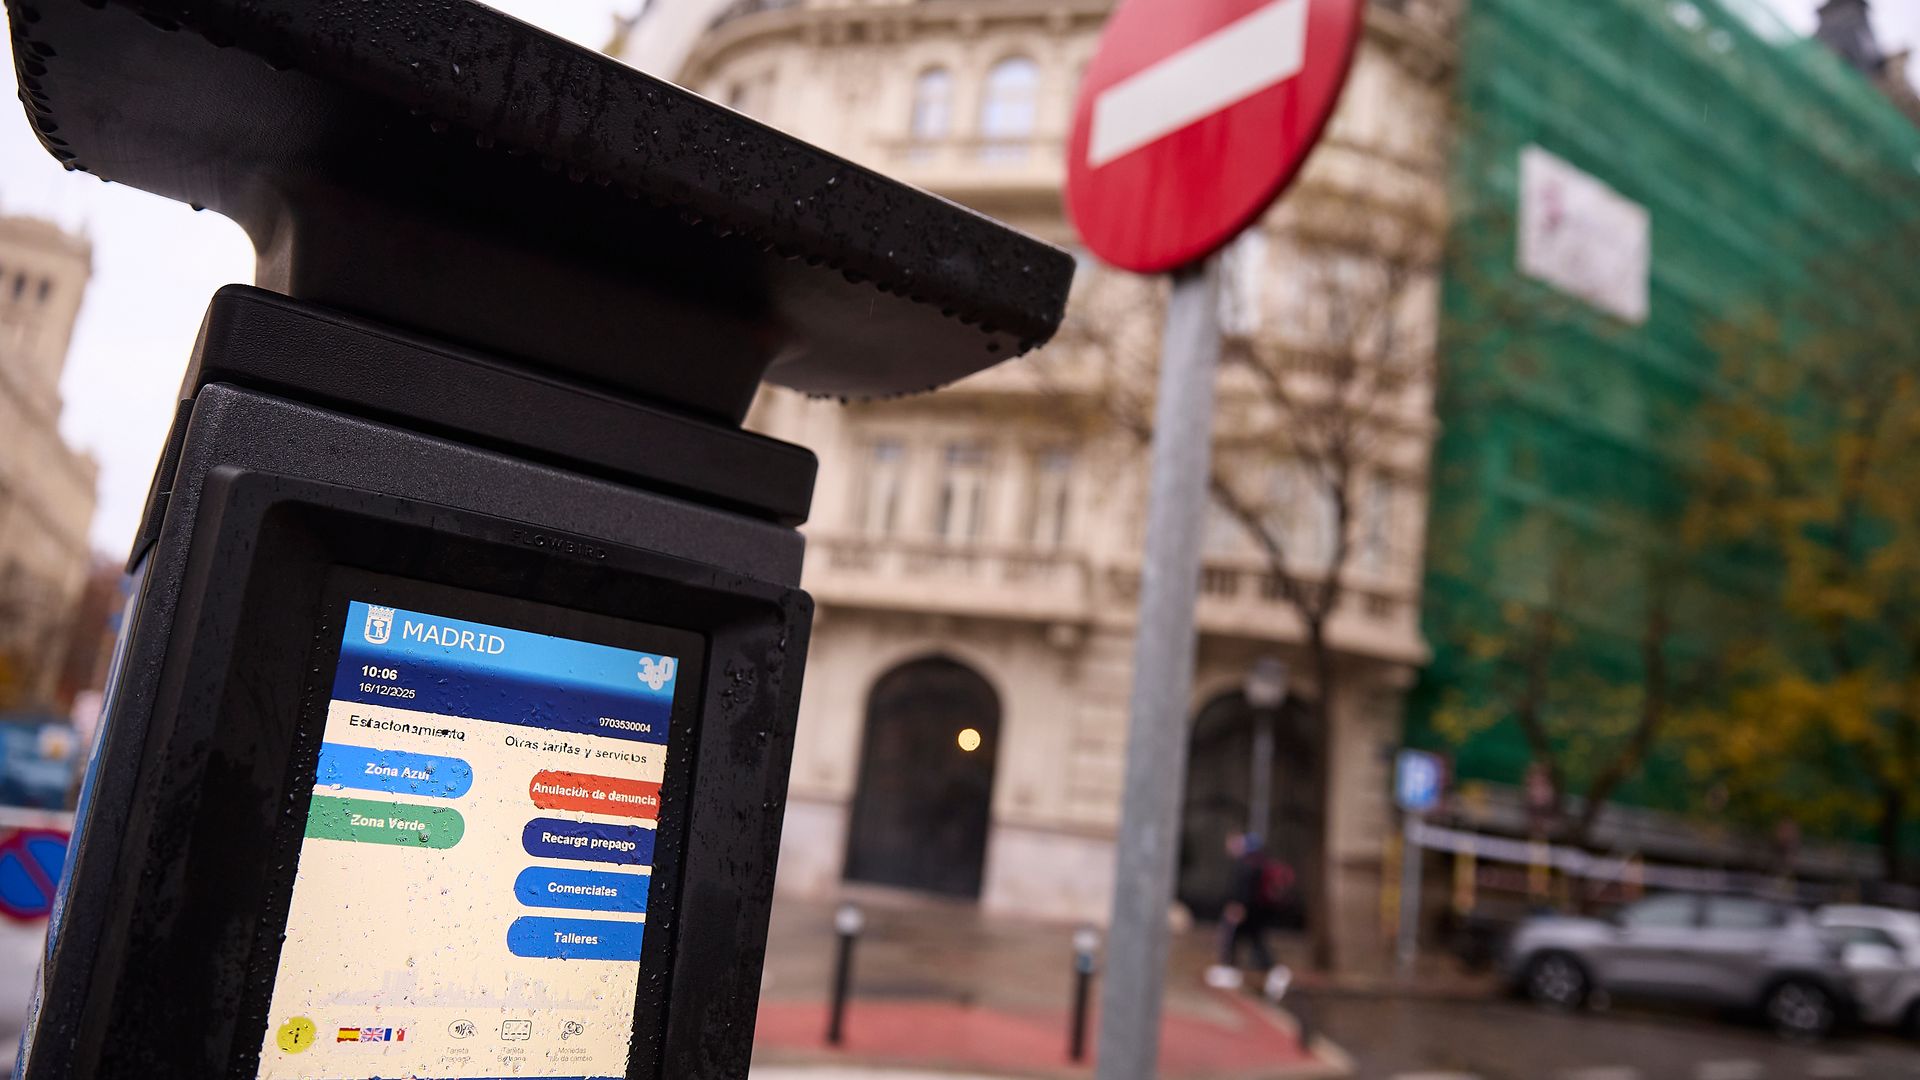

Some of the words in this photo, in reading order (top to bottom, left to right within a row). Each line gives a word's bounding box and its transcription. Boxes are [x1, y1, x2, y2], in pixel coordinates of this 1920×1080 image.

[402, 620, 505, 655] MADRID
[361, 665, 398, 681] 10:06
[358, 682, 416, 699] 16/12/2025
[599, 717, 651, 733] 0703530004
[584, 748, 593, 758] y
[364, 762, 399, 777] Zona
[591, 789, 606, 800] de
[608, 790, 657, 806] denuncia
[350, 814, 385, 828] Zona
[388, 817, 426, 831] Verde
[541, 832, 588, 848] Recarga
[590, 838, 636, 852] prepago
[547, 882, 618, 897] Comerciales
[554, 932, 599, 945] Talleres
